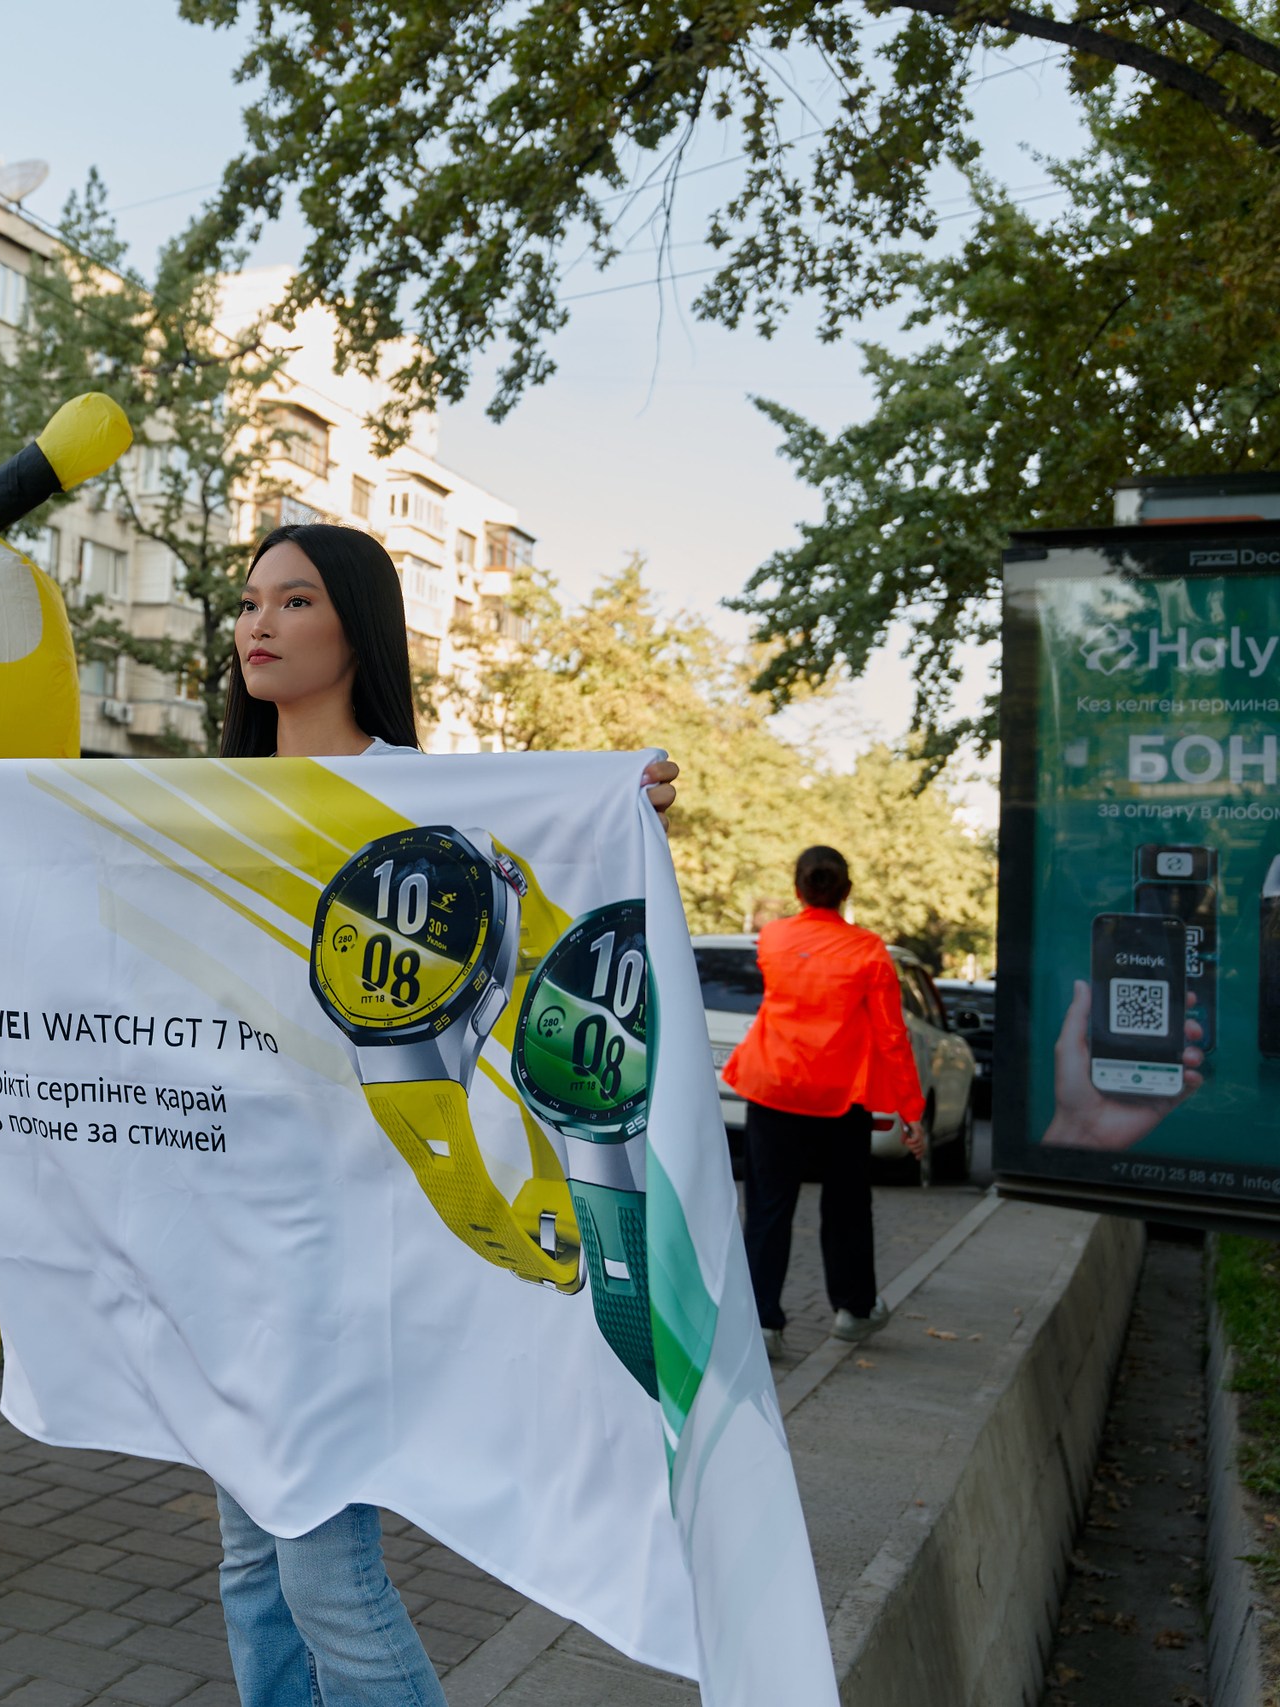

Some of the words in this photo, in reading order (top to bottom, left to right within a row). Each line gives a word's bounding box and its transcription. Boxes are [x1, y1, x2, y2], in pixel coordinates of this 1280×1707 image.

[1077, 696, 1111, 713] Кез
[1116, 698, 1184, 714] келген
[1190, 698, 1280, 715] термина
[1129, 735, 1277, 785] БОН
[1097, 803, 1120, 818] за
[1124, 804, 1197, 822] оплату
[1201, 806, 1212, 819] в
[373, 859, 429, 935] 10
[338, 935, 353, 944] 280
[426, 933, 448, 951] Уклон
[361, 932, 421, 1009] 08
[1130, 953, 1166, 968] Halyk
[589, 930, 645, 1019] 10
[375, 994, 385, 1003] 18
[433, 1013, 451, 1032] 25
[543, 1018, 559, 1027] 280
[41, 1012, 155, 1047] WATCH
[164, 1017, 203, 1049] GT
[212, 1019, 228, 1050] 7
[238, 1020, 279, 1054] Pro
[572, 1013, 626, 1102] 08
[586, 1081, 597, 1090] 18
[37, 1076, 147, 1109] серпінге
[155, 1085, 227, 1117] қарай
[8, 1114, 78, 1142] погоне
[87, 1123, 117, 1144] за
[128, 1124, 226, 1153] стихией
[624, 1115, 646, 1136] 25
[1112, 1162, 1128, 1175] +7
[1131, 1163, 1166, 1182] (727)
